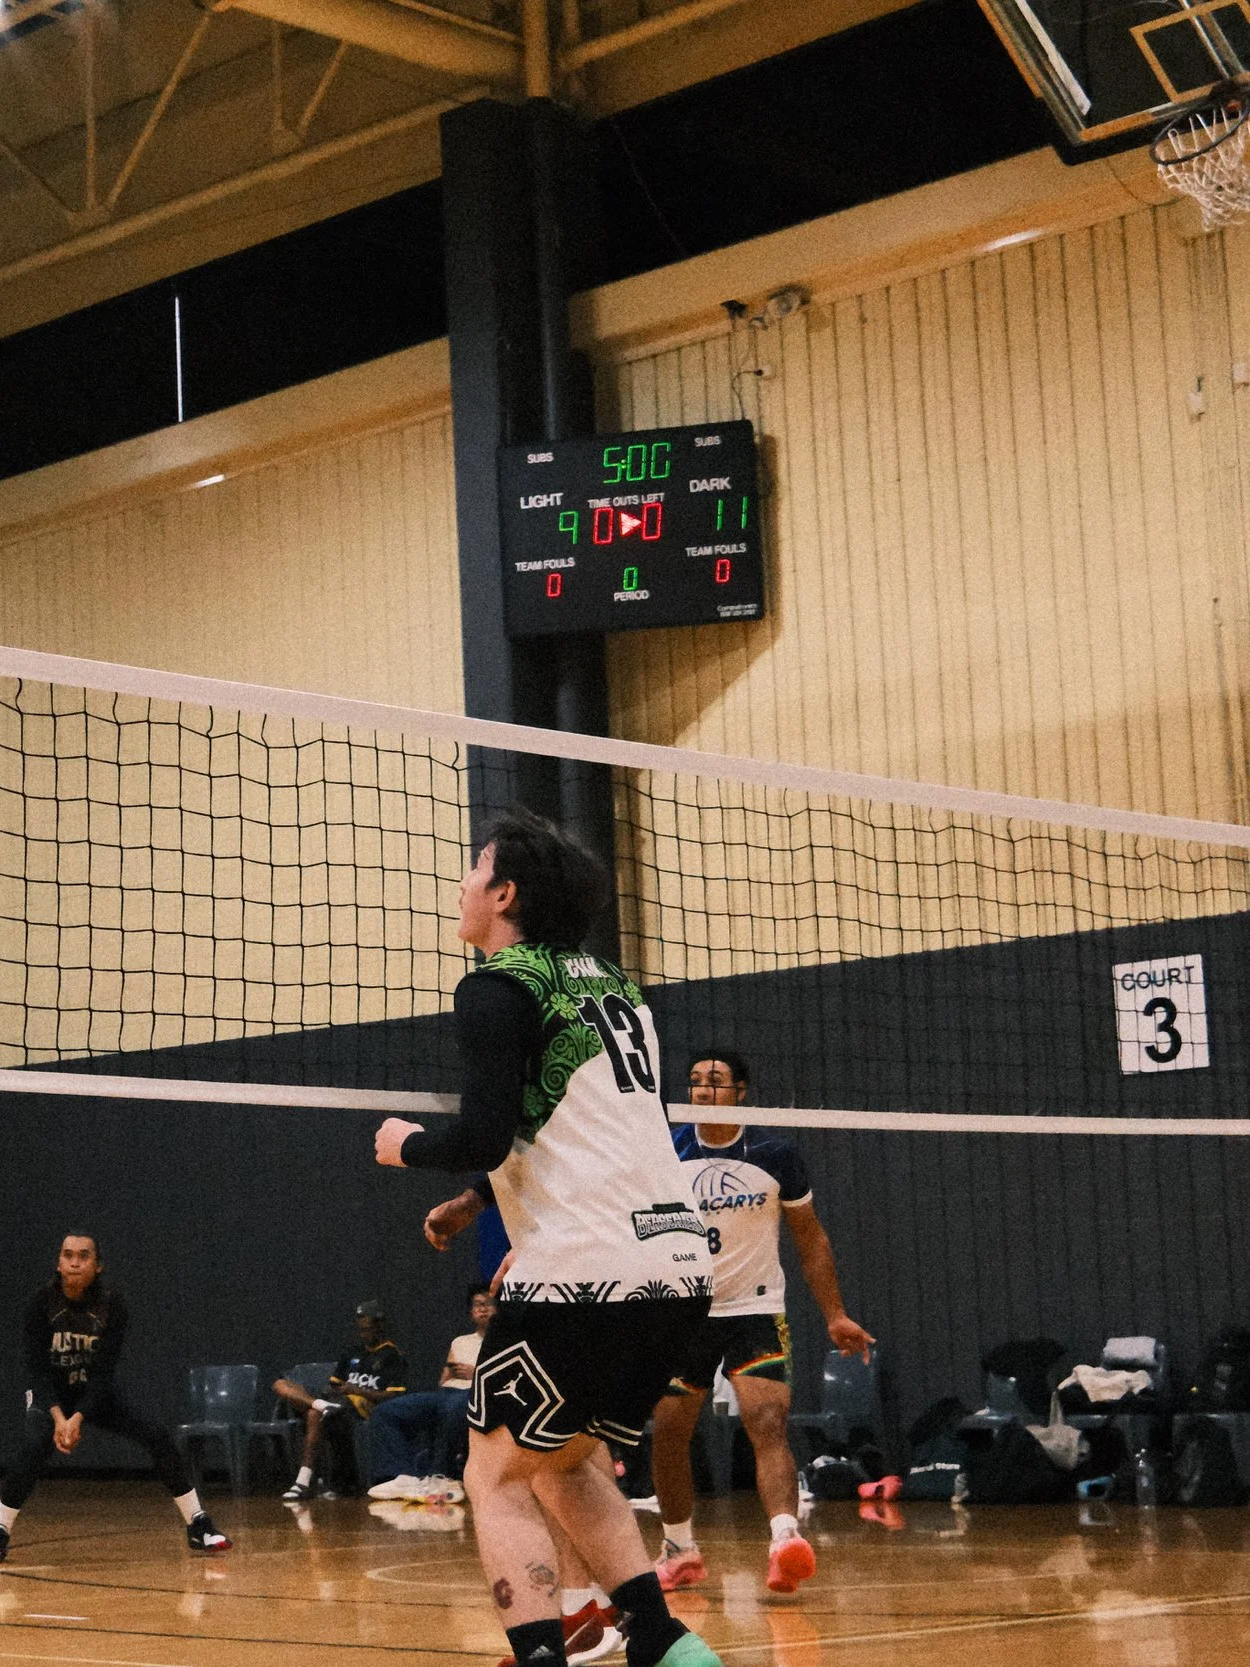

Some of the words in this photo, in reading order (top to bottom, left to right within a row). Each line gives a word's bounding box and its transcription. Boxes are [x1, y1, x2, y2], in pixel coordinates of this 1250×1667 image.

[694, 435, 721, 447] SUBS
[527, 452, 554, 464] SUBS
[689, 477, 732, 493] DARK
[520, 493, 564, 509] LIGHT
[587, 498, 610, 509] TIME
[613, 495, 639, 507] OUTS
[641, 492, 665, 504] LEFT
[593, 506, 614, 545] 0
[641, 501, 662, 541] 0
[717, 496, 748, 531] 11
[558, 511, 579, 545] 9
[685, 545, 713, 557] TEAM
[714, 542, 747, 555] FOULS
[515, 560, 543, 572] TEAM
[543, 557, 576, 570] FOULS
[715, 558, 731, 584] 0
[546, 571, 562, 599] 0
[622, 566, 638, 591] 0
[613, 590, 649, 602] PERIOD
[1121, 966, 1194, 991] COURT
[1143, 997, 1182, 1063] 3
[576, 992, 657, 1094] 13
[699, 1192, 768, 1211] ACARYS
[672, 1253, 698, 1262] GAME
